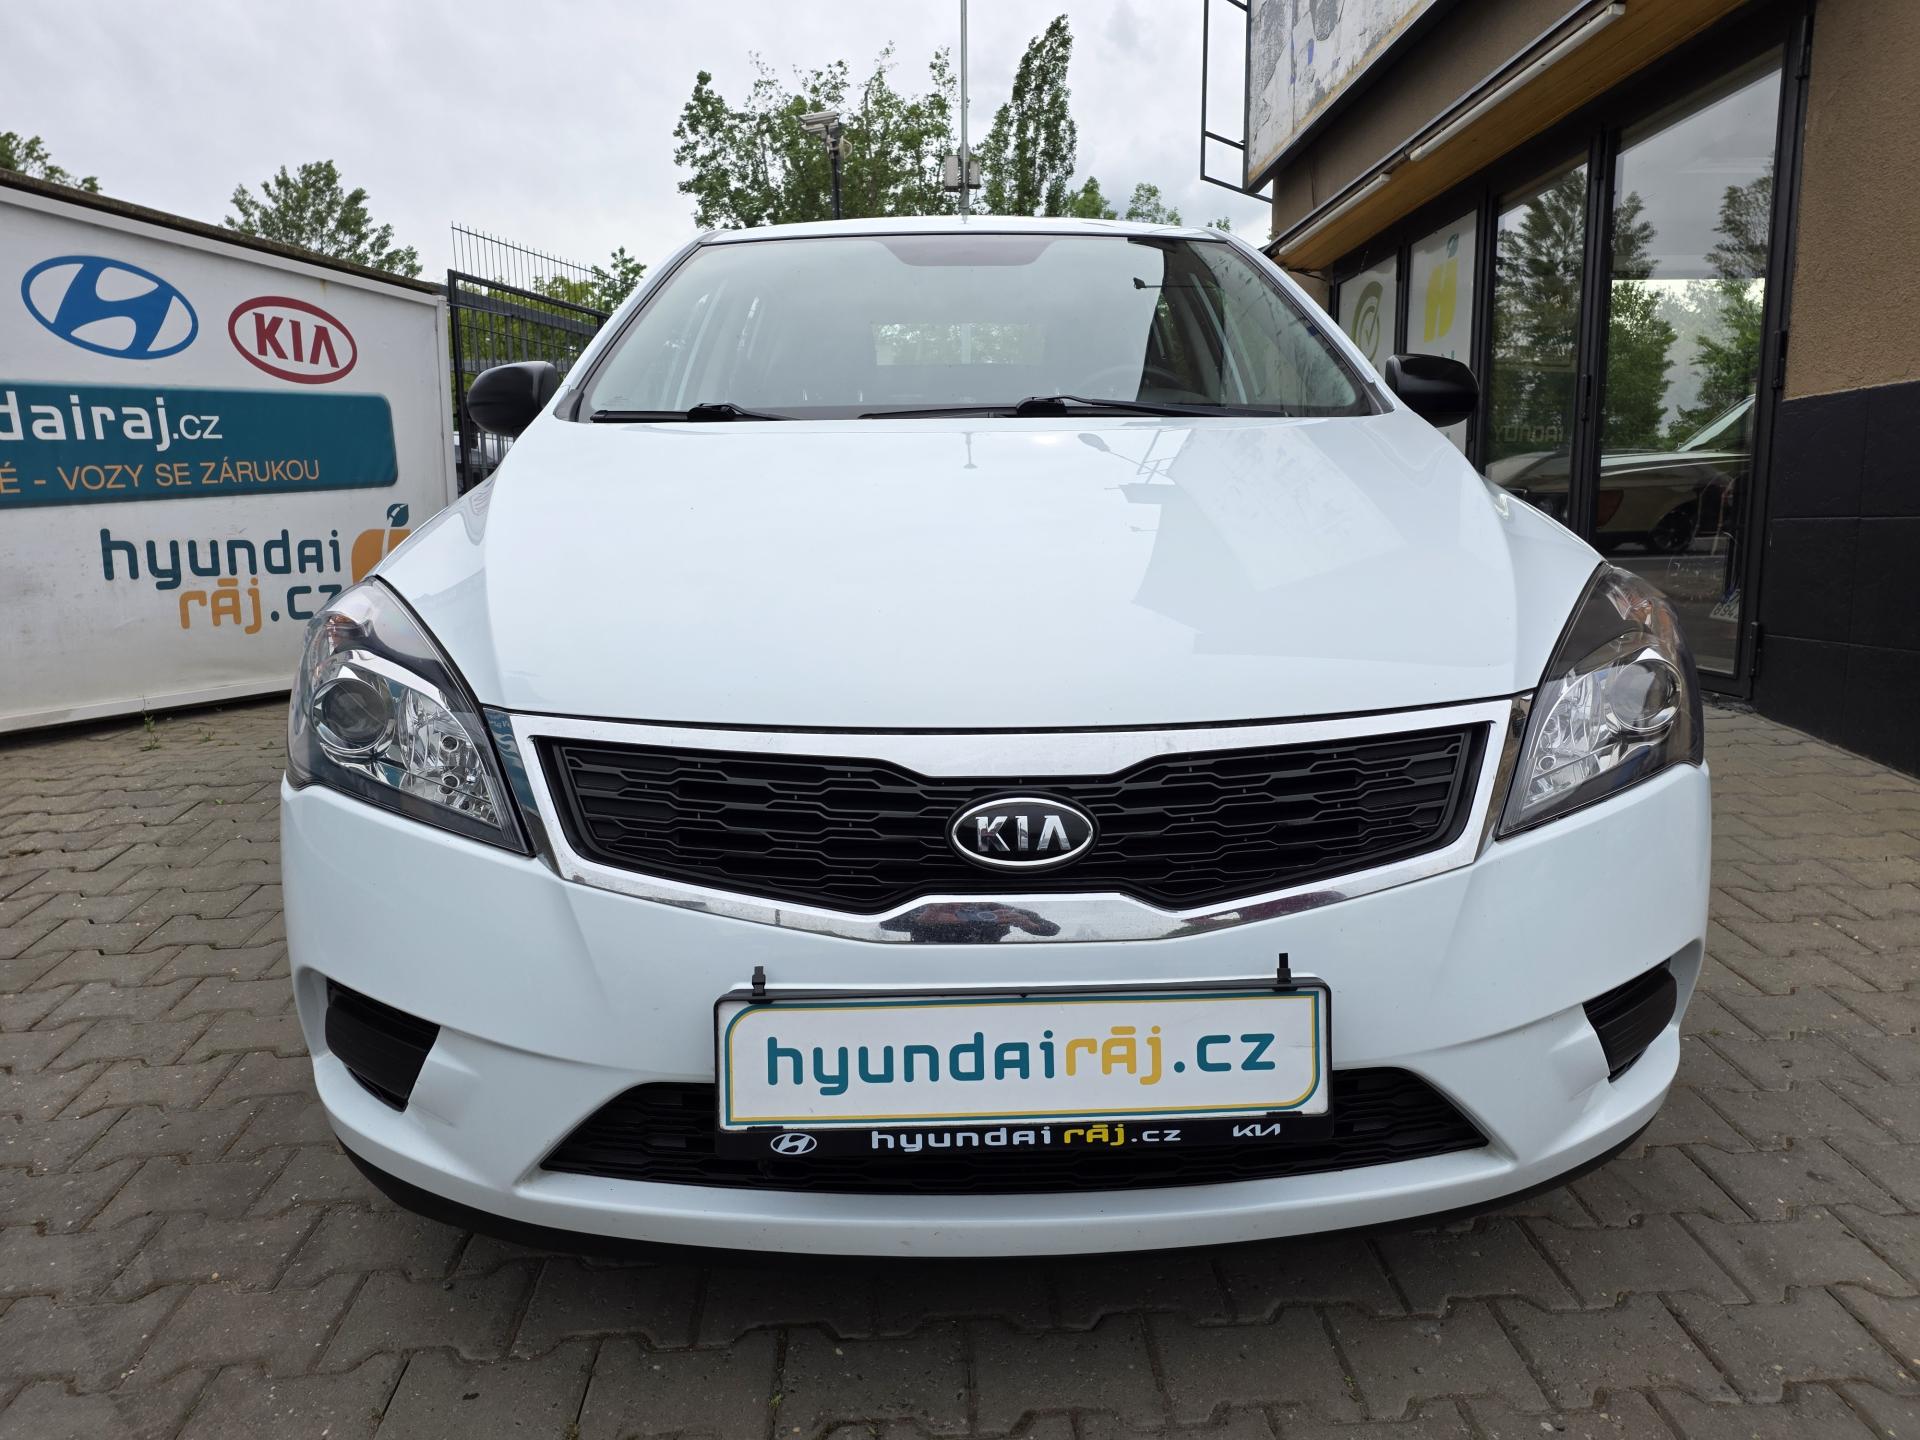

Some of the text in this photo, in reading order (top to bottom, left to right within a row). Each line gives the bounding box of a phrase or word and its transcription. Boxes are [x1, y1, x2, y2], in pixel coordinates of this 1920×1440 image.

[254, 312, 339, 369] KIA
[57, 463, 144, 491] VOZY
[154, 462, 192, 488] SE
[200, 456, 320, 486] ZÁRUKOU
[975, 814, 1072, 852] KIA
